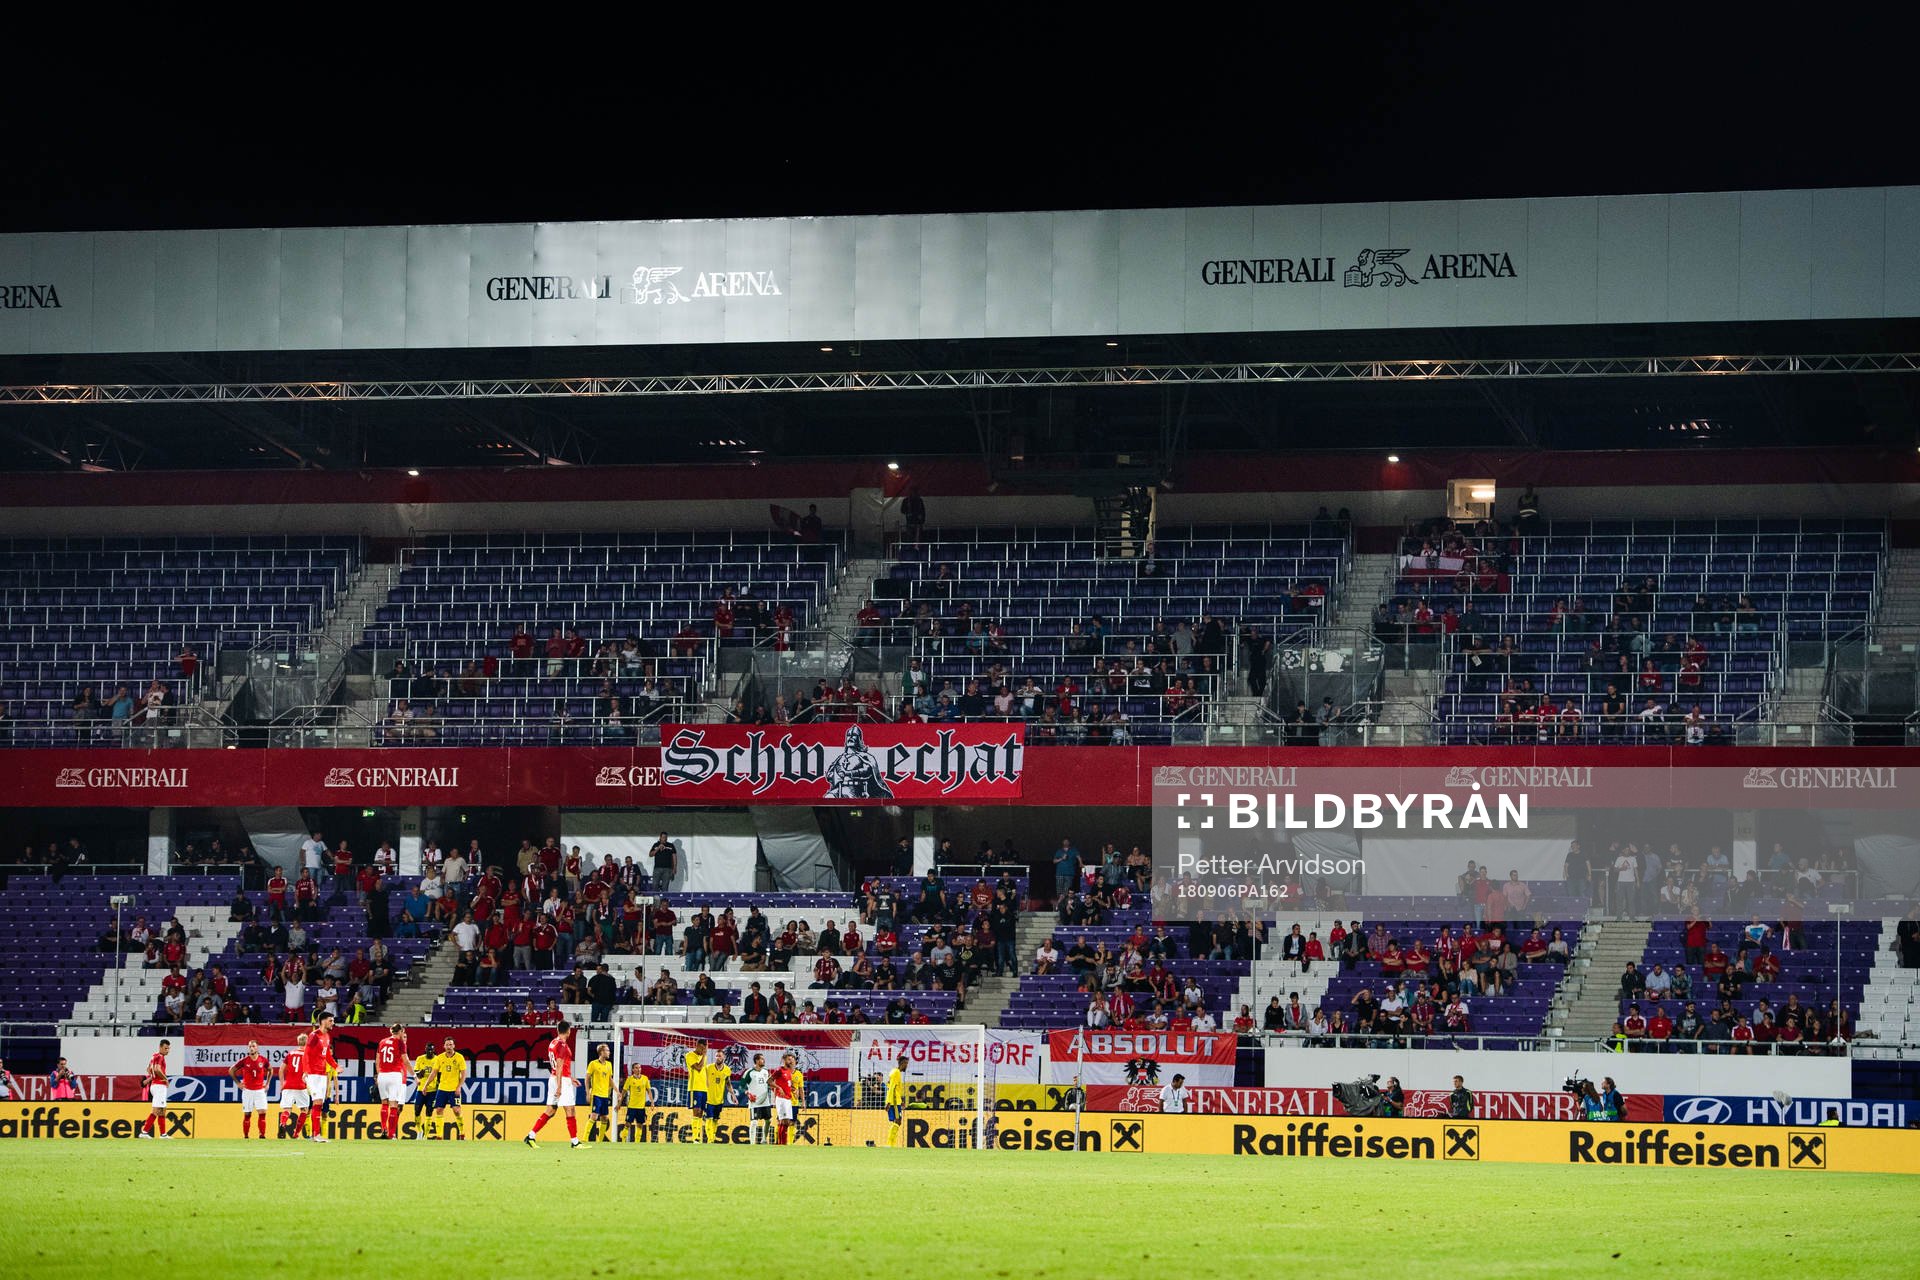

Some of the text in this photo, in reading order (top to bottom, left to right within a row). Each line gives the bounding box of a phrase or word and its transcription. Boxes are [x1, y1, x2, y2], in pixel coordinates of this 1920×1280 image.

[1202, 252, 1517, 286] GENERALI ARENA
[0, 284, 63, 309] RENA
[486, 269, 783, 301] GENERALI ARENA
[88, 768, 188, 788] GENERALI
[357, 767, 459, 788] GENERALI
[1188, 766, 1298, 788] GENERALI
[1480, 766, 1593, 788] GENERALI
[1780, 767, 1897, 789] GENERALI
[380, 1046, 395, 1063] 15
[1067, 1033, 1219, 1057] ABSOLUT
[292, 1056, 300, 1073] 4
[0, 1107, 155, 1139] aiffeisen
[1746, 1100, 1905, 1128] HYUNDAI
[907, 1118, 1101, 1152] Raiffeisen
[1233, 1122, 1435, 1159] Raiffeisen
[1569, 1128, 1780, 1167] Raiffeisen
